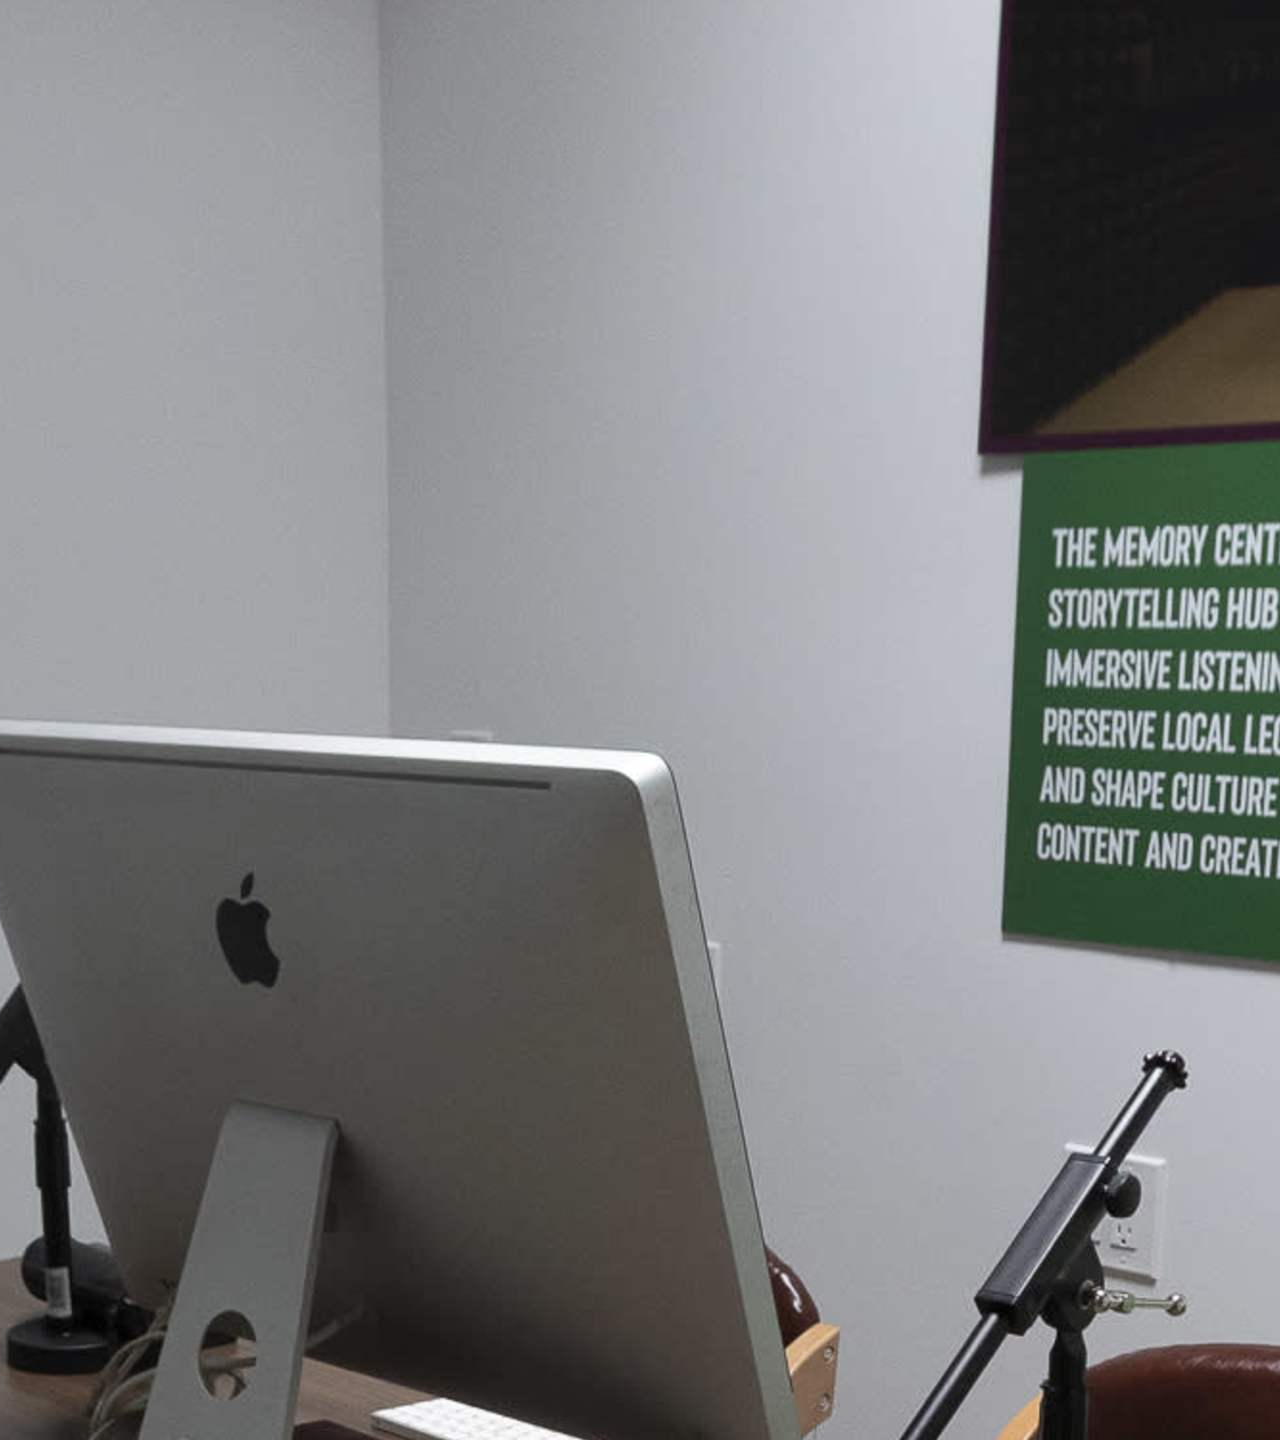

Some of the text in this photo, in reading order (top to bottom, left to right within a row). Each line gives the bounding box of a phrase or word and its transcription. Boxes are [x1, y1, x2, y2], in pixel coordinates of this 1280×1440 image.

[1052, 527, 1097, 567] THE
[1103, 525, 1207, 567] MEMORY
[1047, 587, 1219, 629] STORYTELLING
[1226, 588, 1278, 629] HUB
[1045, 649, 1171, 689] IMMERSIVE
[1042, 707, 1156, 749] PRESERVE
[1162, 712, 1235, 753] LOCAL
[1040, 766, 1085, 803] AND
[1090, 768, 1165, 809] SHAPE
[1171, 771, 1279, 817] CULTURE
[1036, 822, 1139, 865] CONTENT
[1144, 830, 1192, 870] AND
